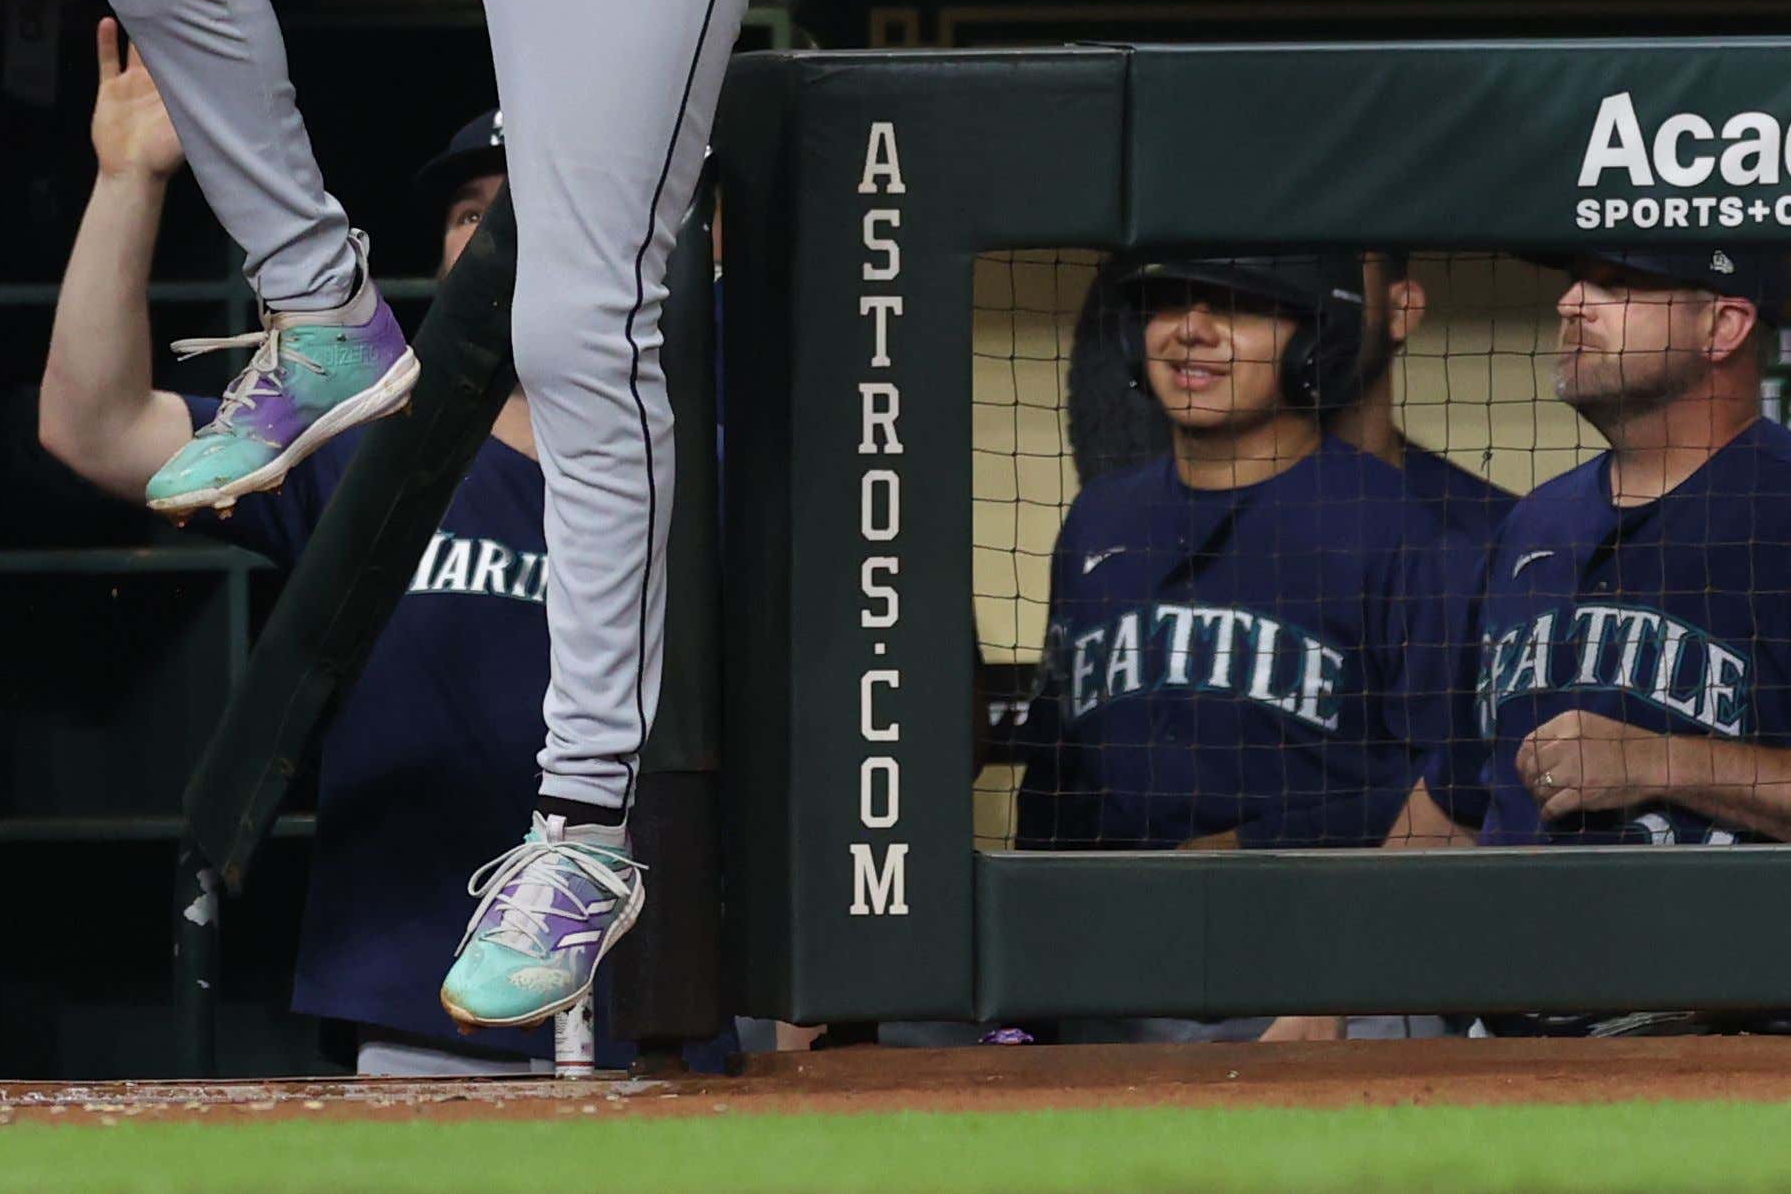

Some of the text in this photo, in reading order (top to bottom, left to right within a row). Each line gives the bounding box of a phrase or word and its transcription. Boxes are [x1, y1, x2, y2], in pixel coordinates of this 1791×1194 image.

[1578, 91, 1791, 188] Aca
[1051, 603, 1345, 731] EATTLE
[1477, 603, 1749, 736] EATTLE
